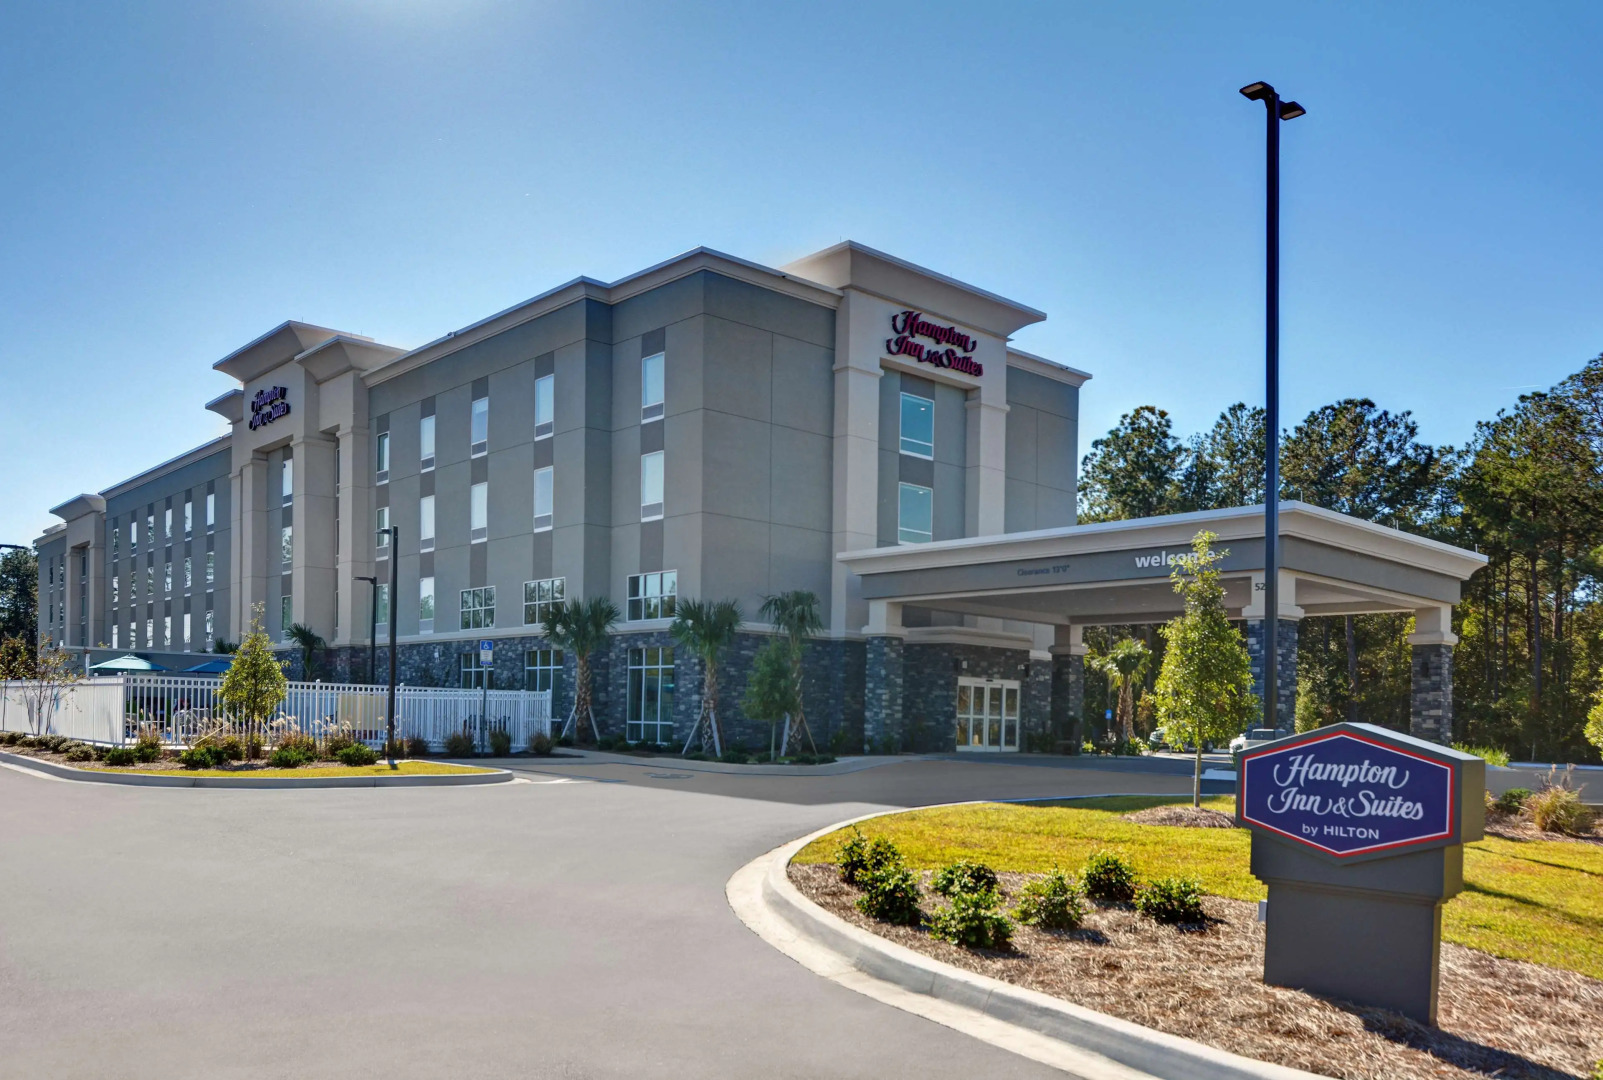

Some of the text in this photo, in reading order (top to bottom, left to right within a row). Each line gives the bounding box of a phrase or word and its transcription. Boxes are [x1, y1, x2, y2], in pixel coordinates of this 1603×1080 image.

[892, 310, 977, 353] Hampton
[886, 335, 931, 363] Inn
[939, 348, 984, 377] Suites
[251, 386, 287, 412] Hampton
[1273, 754, 1409, 789] Hampton
[1267, 788, 1424, 820] Inn & Suites
[1302, 824, 1379, 839] by HILTON
